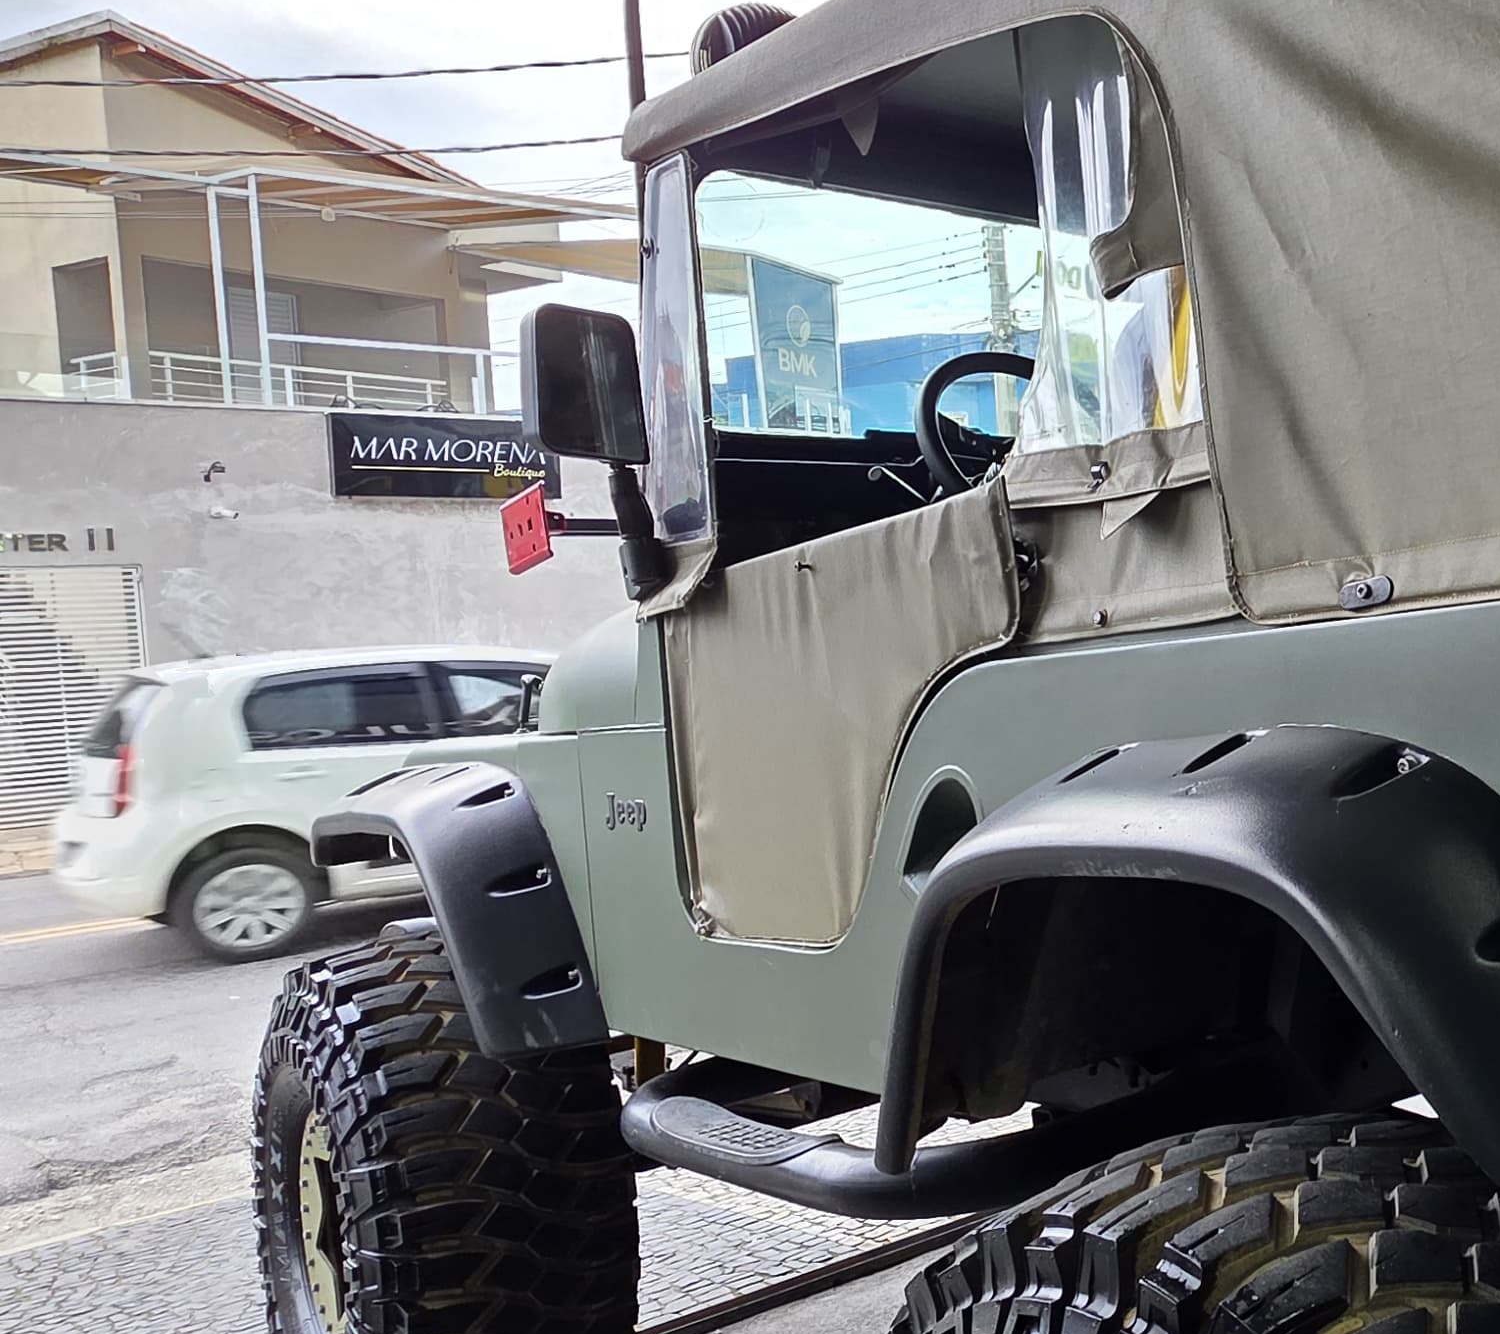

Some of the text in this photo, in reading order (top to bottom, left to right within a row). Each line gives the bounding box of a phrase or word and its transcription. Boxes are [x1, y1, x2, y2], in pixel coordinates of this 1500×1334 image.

[778, 348, 817, 378] BMK
[350, 435, 547, 465] MAR MORENA
[493, 463, 547, 481] Boutique
[605, 791, 648, 833] Jeep
